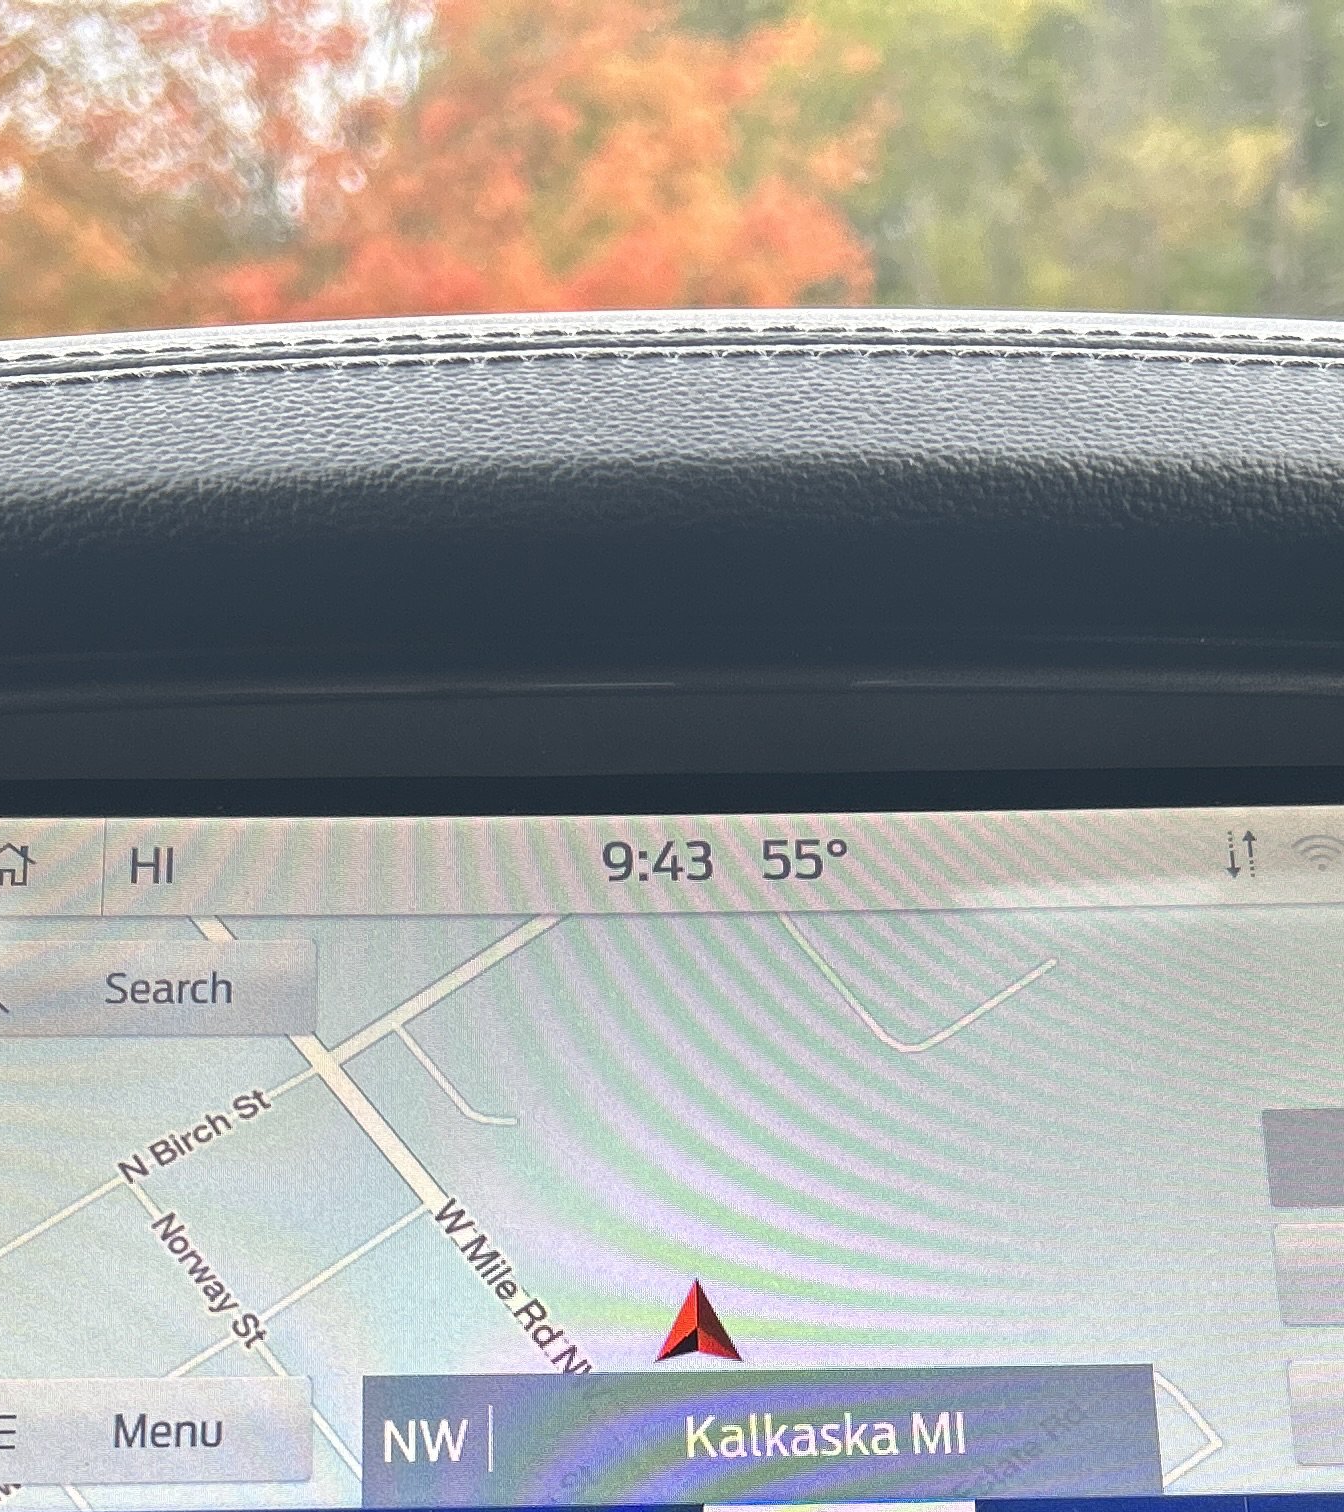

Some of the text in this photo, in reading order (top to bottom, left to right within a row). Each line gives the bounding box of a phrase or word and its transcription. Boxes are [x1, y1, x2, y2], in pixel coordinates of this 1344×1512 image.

[129, 846, 175, 885] HI
[601, 839, 714, 883] 9:43
[761, 838, 849, 882] 55°
[104, 970, 233, 1005] Search
[117, 1089, 272, 1185] N Birch St
[151, 1211, 268, 1350] Norway St
[434, 1197, 593, 1375] W Mile Rd N
[113, 1413, 224, 1449] Menu
[383, 1418, 470, 1464] NW
[685, 1411, 967, 1459] Kalkaska MI
